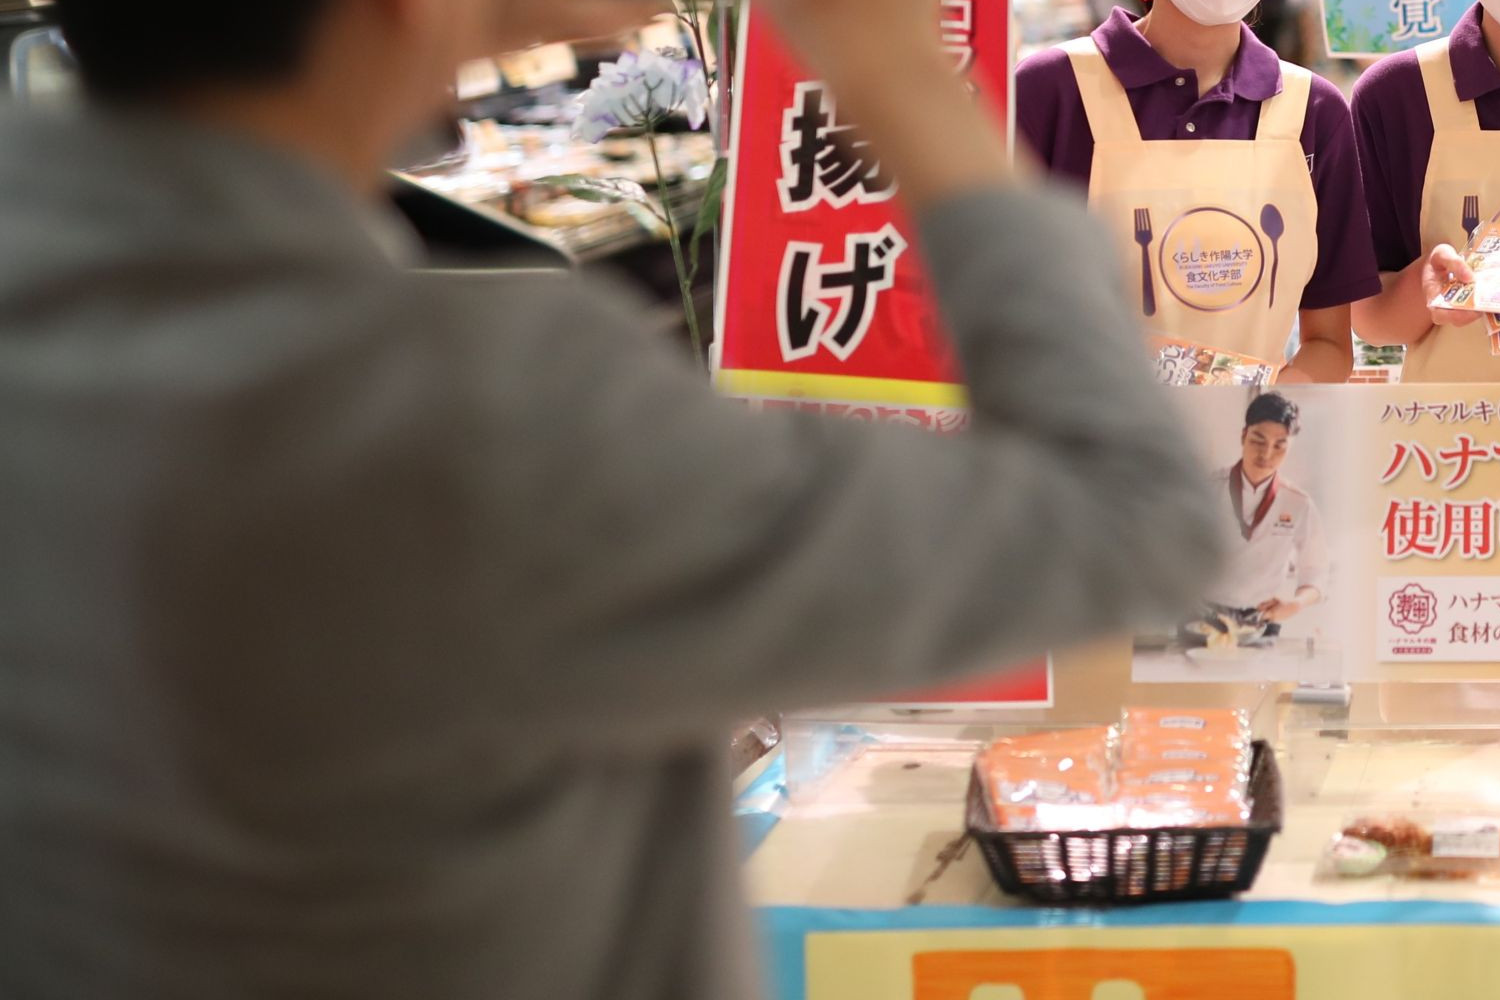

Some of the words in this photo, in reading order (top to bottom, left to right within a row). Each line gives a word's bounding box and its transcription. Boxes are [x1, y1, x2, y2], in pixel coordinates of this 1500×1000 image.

[1172, 249, 1253, 264] くらしき作陽大学
[1186, 269, 1242, 283] 食文化学部
